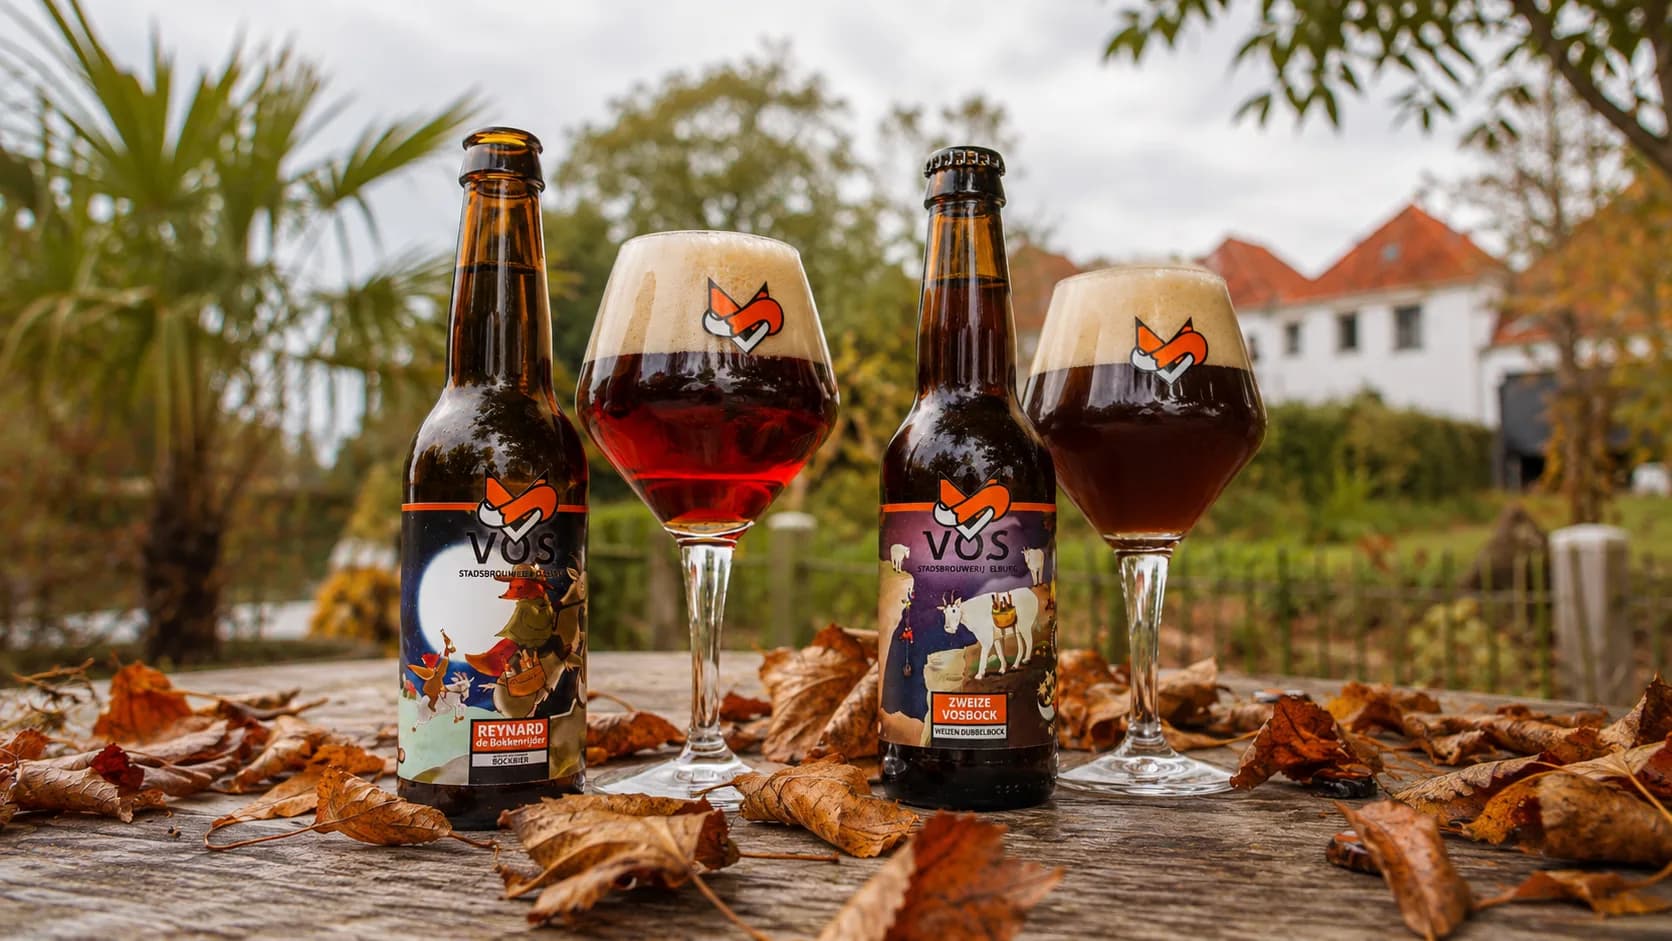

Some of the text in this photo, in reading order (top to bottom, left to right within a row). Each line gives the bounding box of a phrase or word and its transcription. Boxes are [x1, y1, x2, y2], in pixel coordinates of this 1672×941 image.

[466, 532, 555, 565] VOS
[923, 530, 1009, 561] VOS
[917, 565, 985, 574] STADSBROUWERIJ
[948, 697, 991, 708] ZWEIZE
[941, 709, 998, 721] VOSBOCK
[478, 722, 544, 737] REYNARD
[935, 727, 1005, 736] WEIZEN DUBBELBOCK
[475, 738, 489, 748] de
